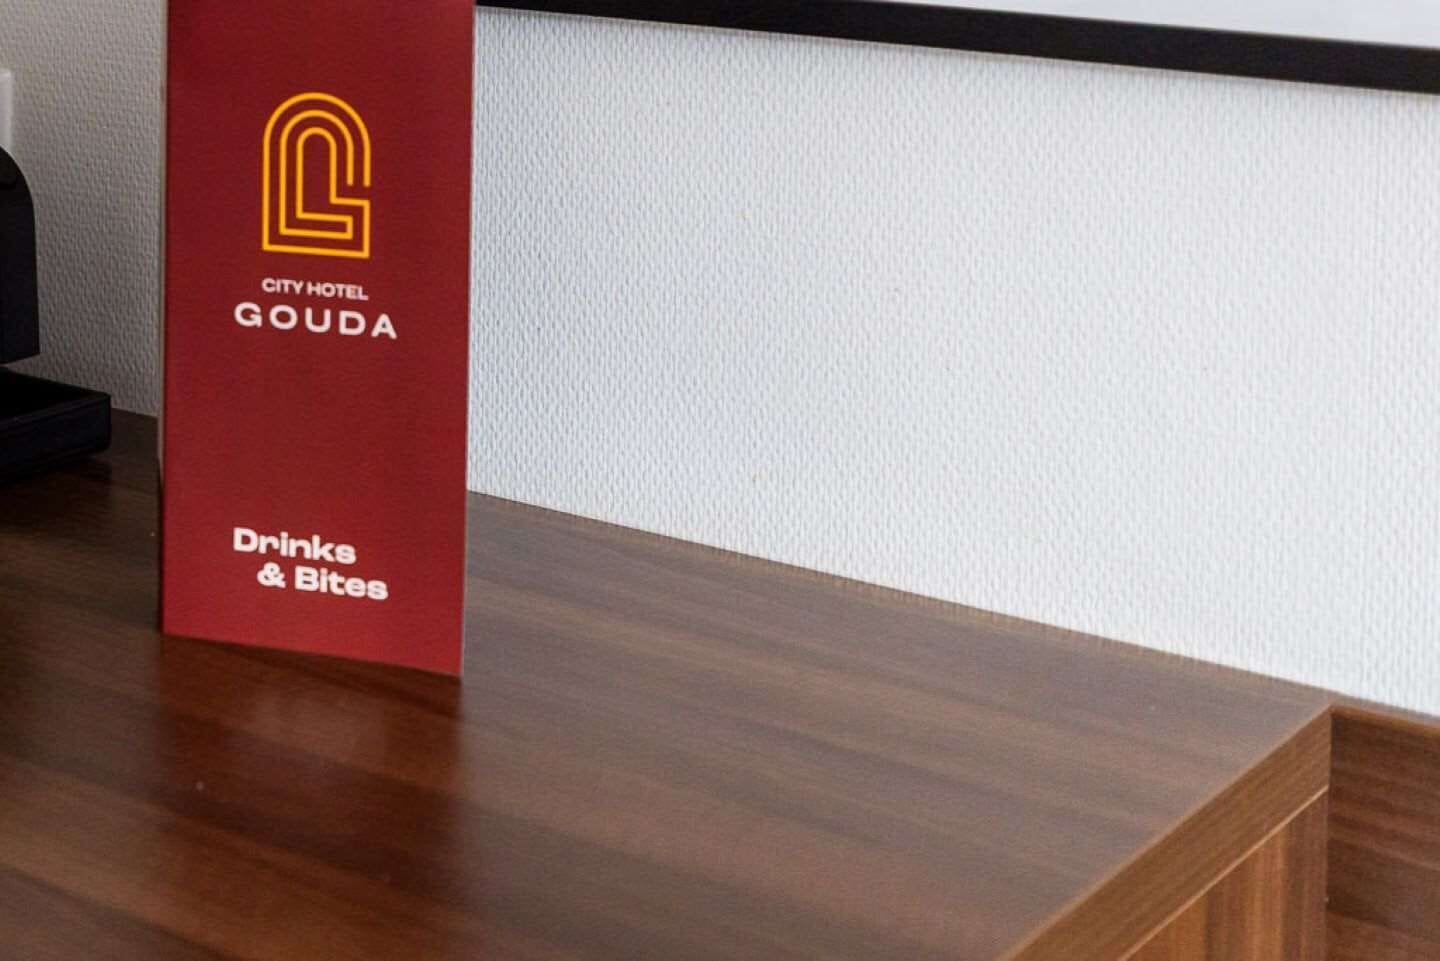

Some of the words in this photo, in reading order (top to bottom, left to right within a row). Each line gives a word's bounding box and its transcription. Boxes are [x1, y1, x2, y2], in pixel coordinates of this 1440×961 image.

[261, 277, 303, 295] CITY
[307, 282, 368, 300] HOTEL
[233, 301, 397, 339] GOUDA
[233, 527, 357, 564] Drinks
[257, 562, 286, 588] &
[294, 565, 389, 600] Bites
